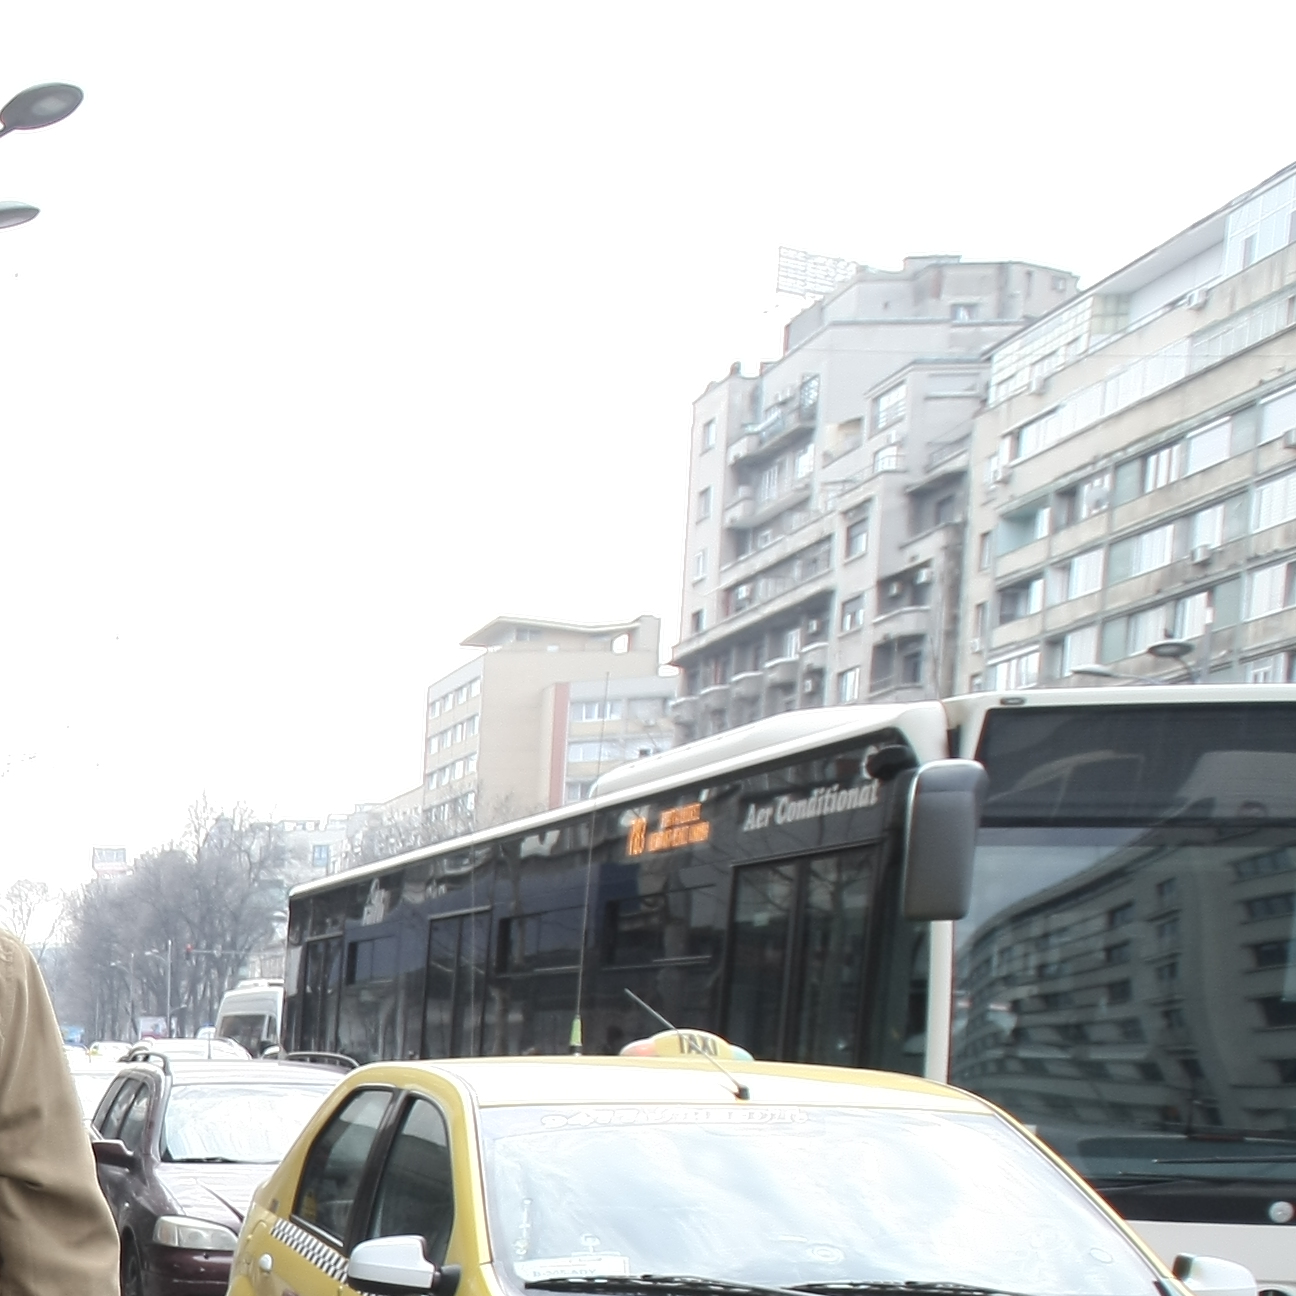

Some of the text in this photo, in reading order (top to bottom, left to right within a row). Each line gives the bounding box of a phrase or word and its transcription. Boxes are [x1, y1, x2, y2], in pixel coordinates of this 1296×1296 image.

[743, 803, 773, 832] Aer
[774, 778, 880, 826] Conditionat
[678, 1032, 719, 1056] TAXI
